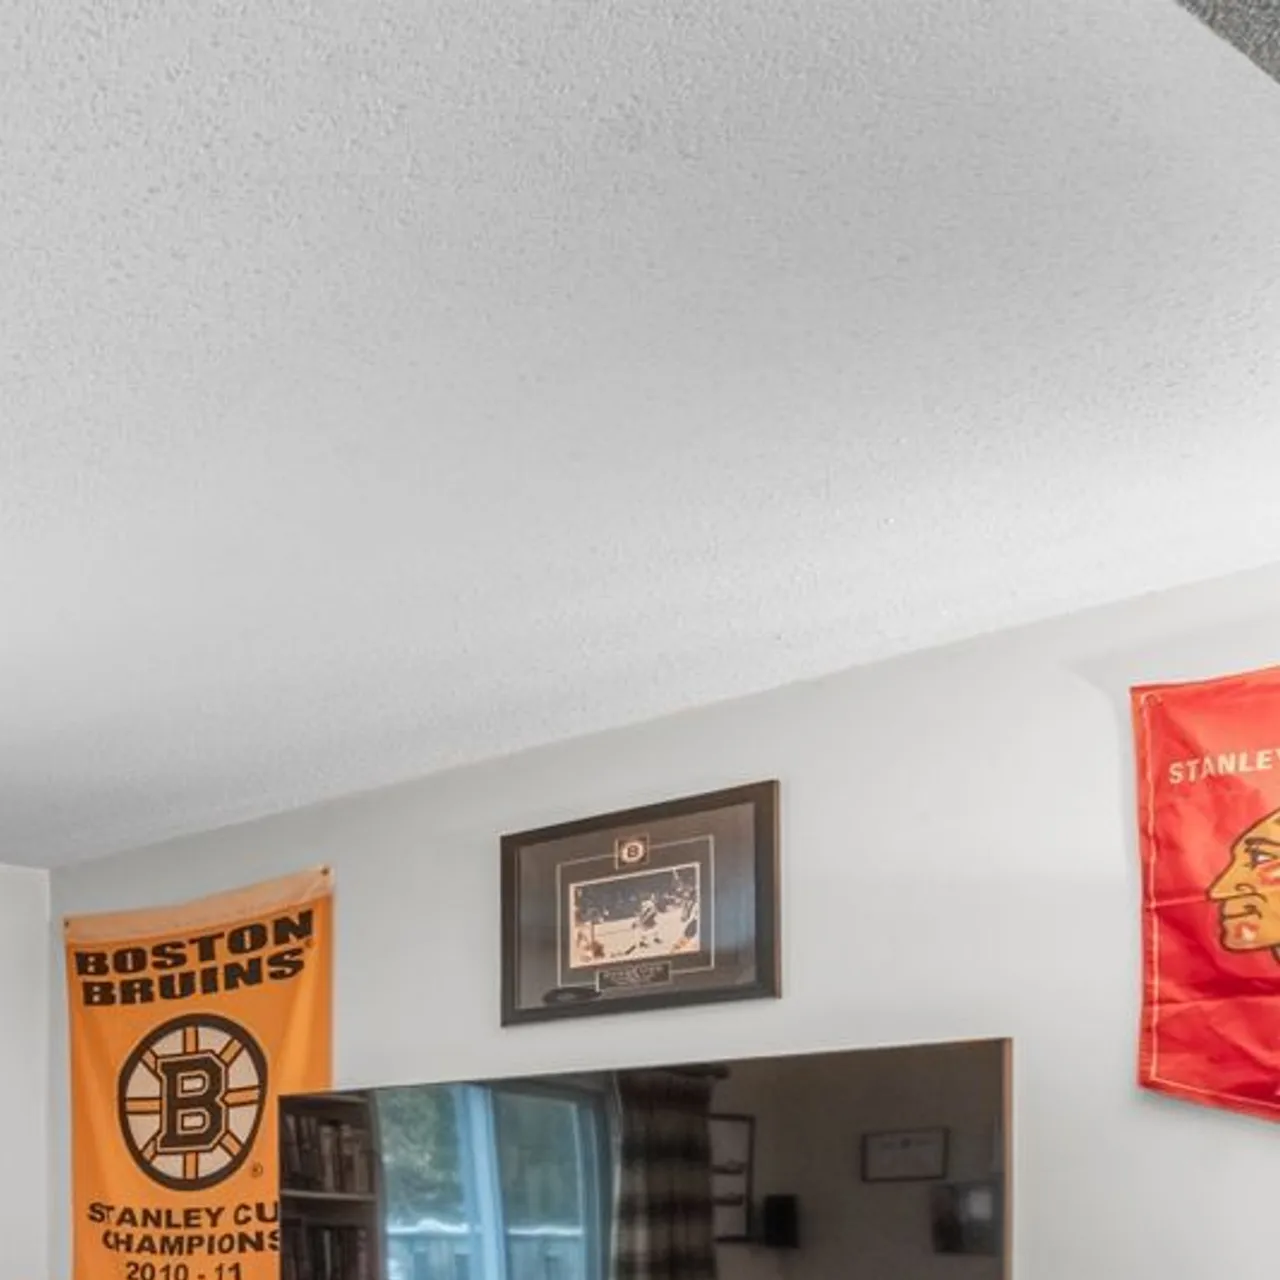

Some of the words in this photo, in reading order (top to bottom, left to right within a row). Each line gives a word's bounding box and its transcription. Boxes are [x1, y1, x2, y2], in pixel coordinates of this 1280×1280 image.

[75, 909, 314, 976] BOSTON
[83, 948, 305, 1006] BRUINS
[157, 1052, 227, 1152] B
[88, 1201, 225, 1229] STANLEY
[234, 1201, 280, 1226] CU
[102, 1230, 280, 1256] CHAMPIONS
